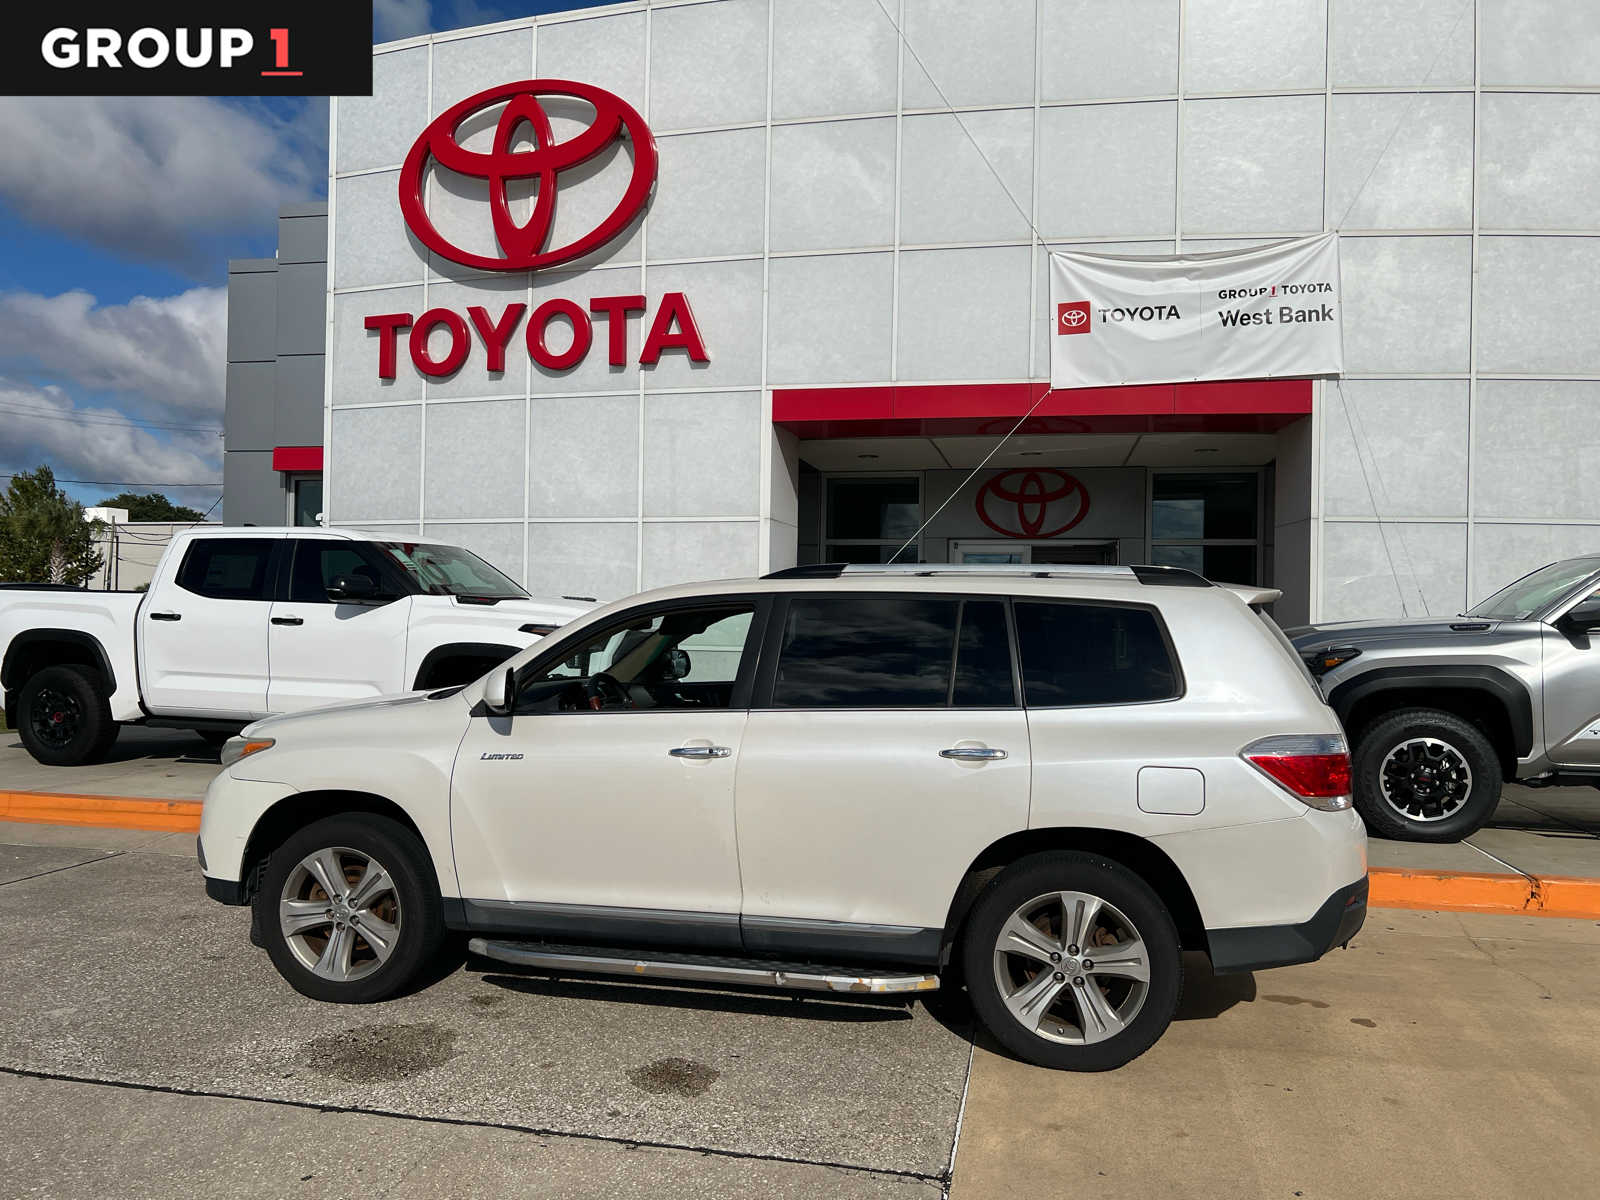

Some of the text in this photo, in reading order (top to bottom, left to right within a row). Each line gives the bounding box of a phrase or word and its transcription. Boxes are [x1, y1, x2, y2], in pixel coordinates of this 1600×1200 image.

[1218, 287, 1267, 299] GROUP
[1281, 283, 1333, 295] TOYOTA
[1098, 305, 1181, 323] TOYOTA
[1218, 304, 1334, 327] West Bank
[364, 292, 711, 379] TOYOTA
